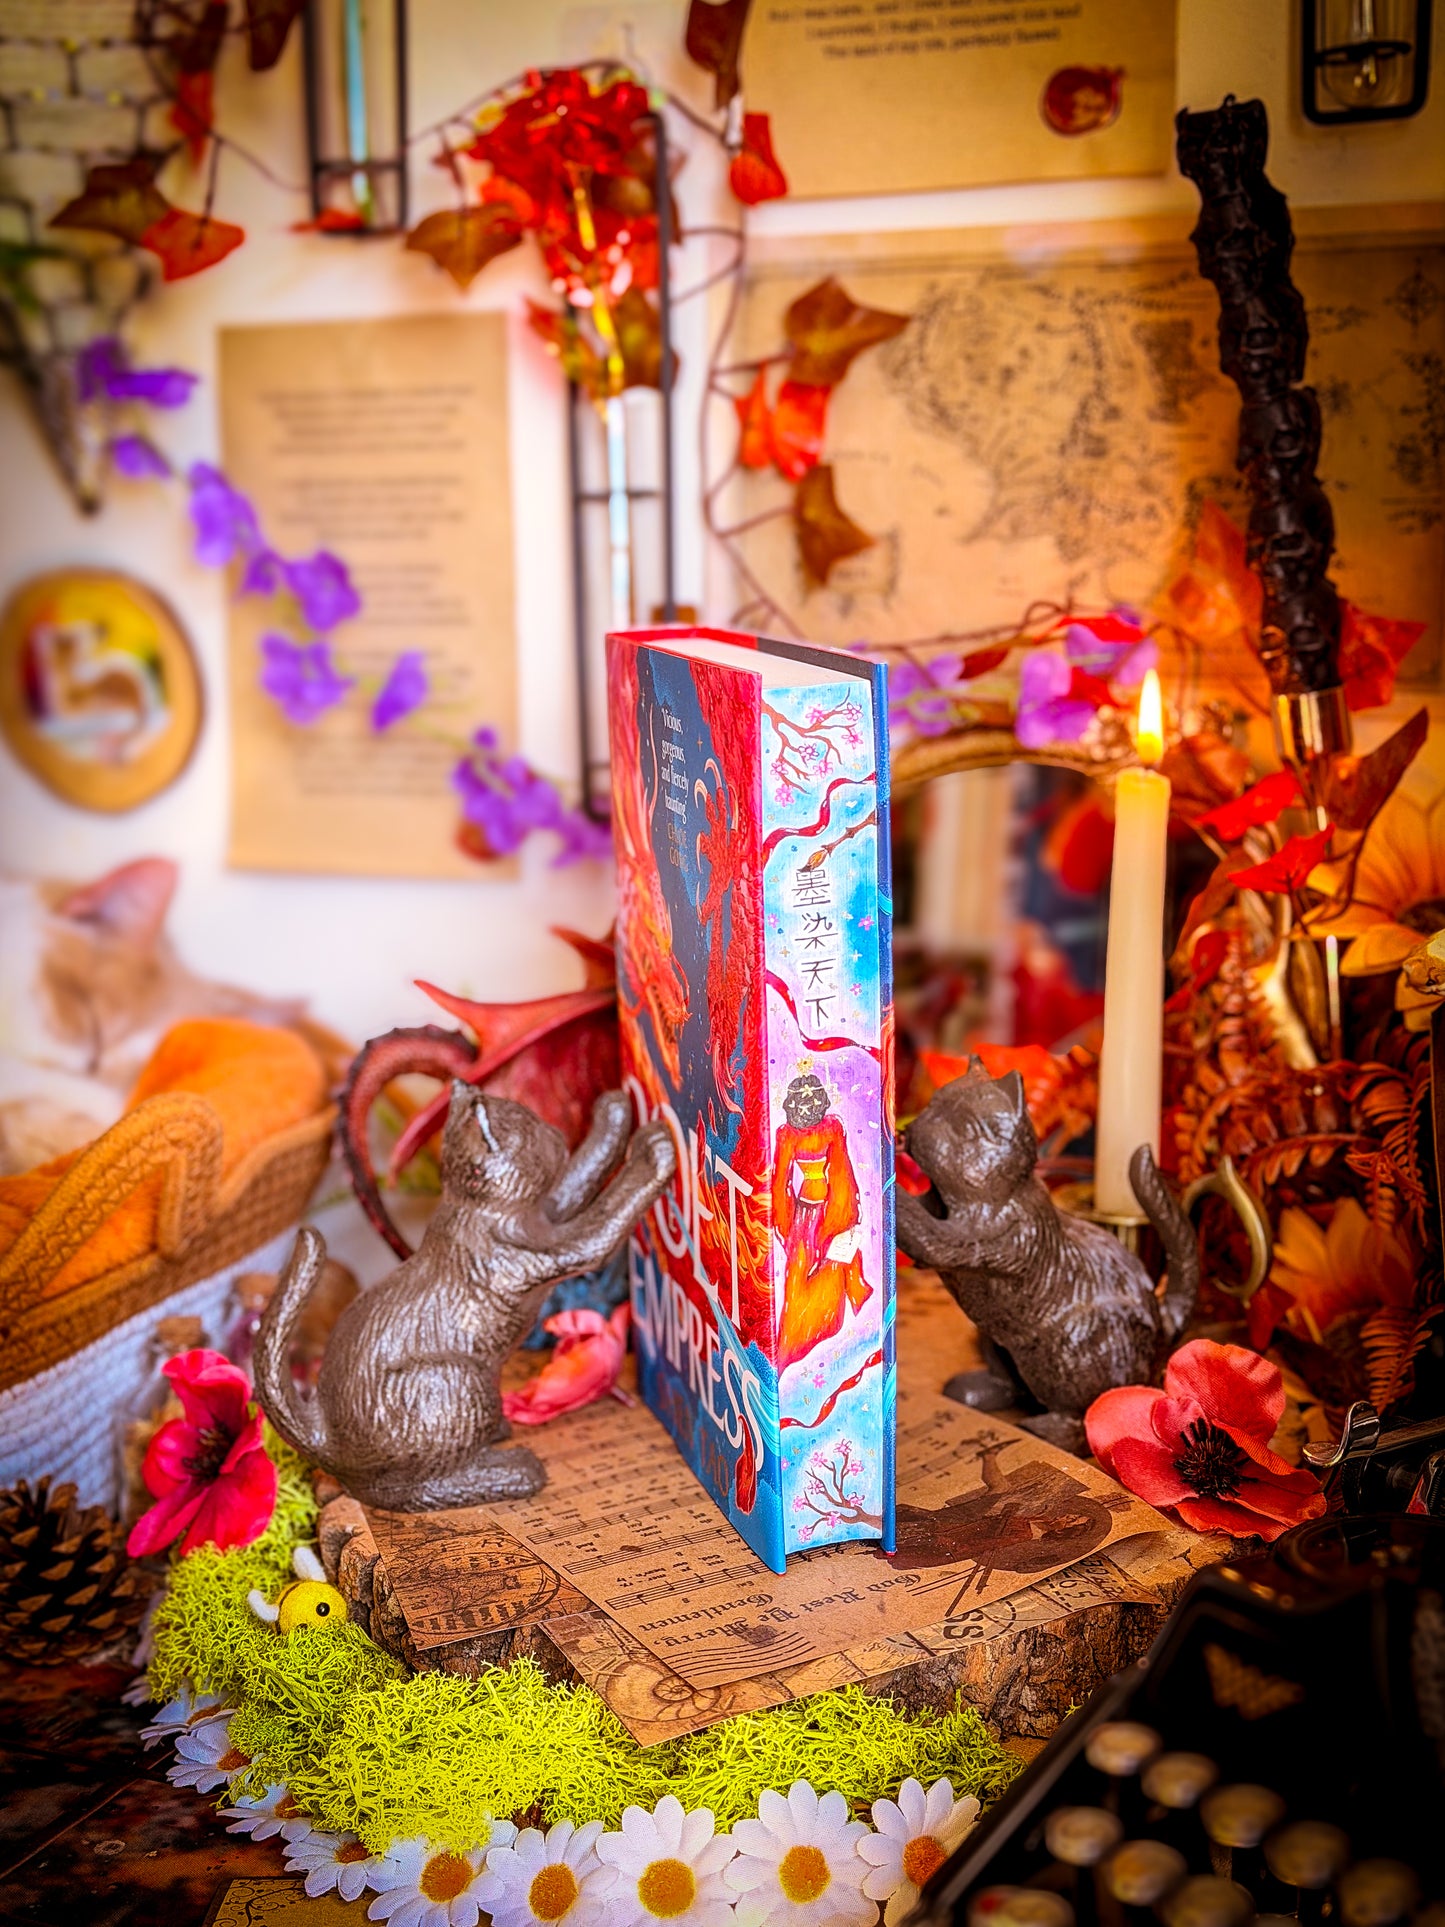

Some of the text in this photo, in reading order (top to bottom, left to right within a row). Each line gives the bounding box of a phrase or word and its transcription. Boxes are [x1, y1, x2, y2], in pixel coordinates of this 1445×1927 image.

[791, 868, 839, 1027] 墨染天下
[628, 1233, 765, 1473] EMPRESS
[637, 1593, 773, 1632] Gentlemen
[651, 1573, 923, 1648] God Rest Ye Merry,
